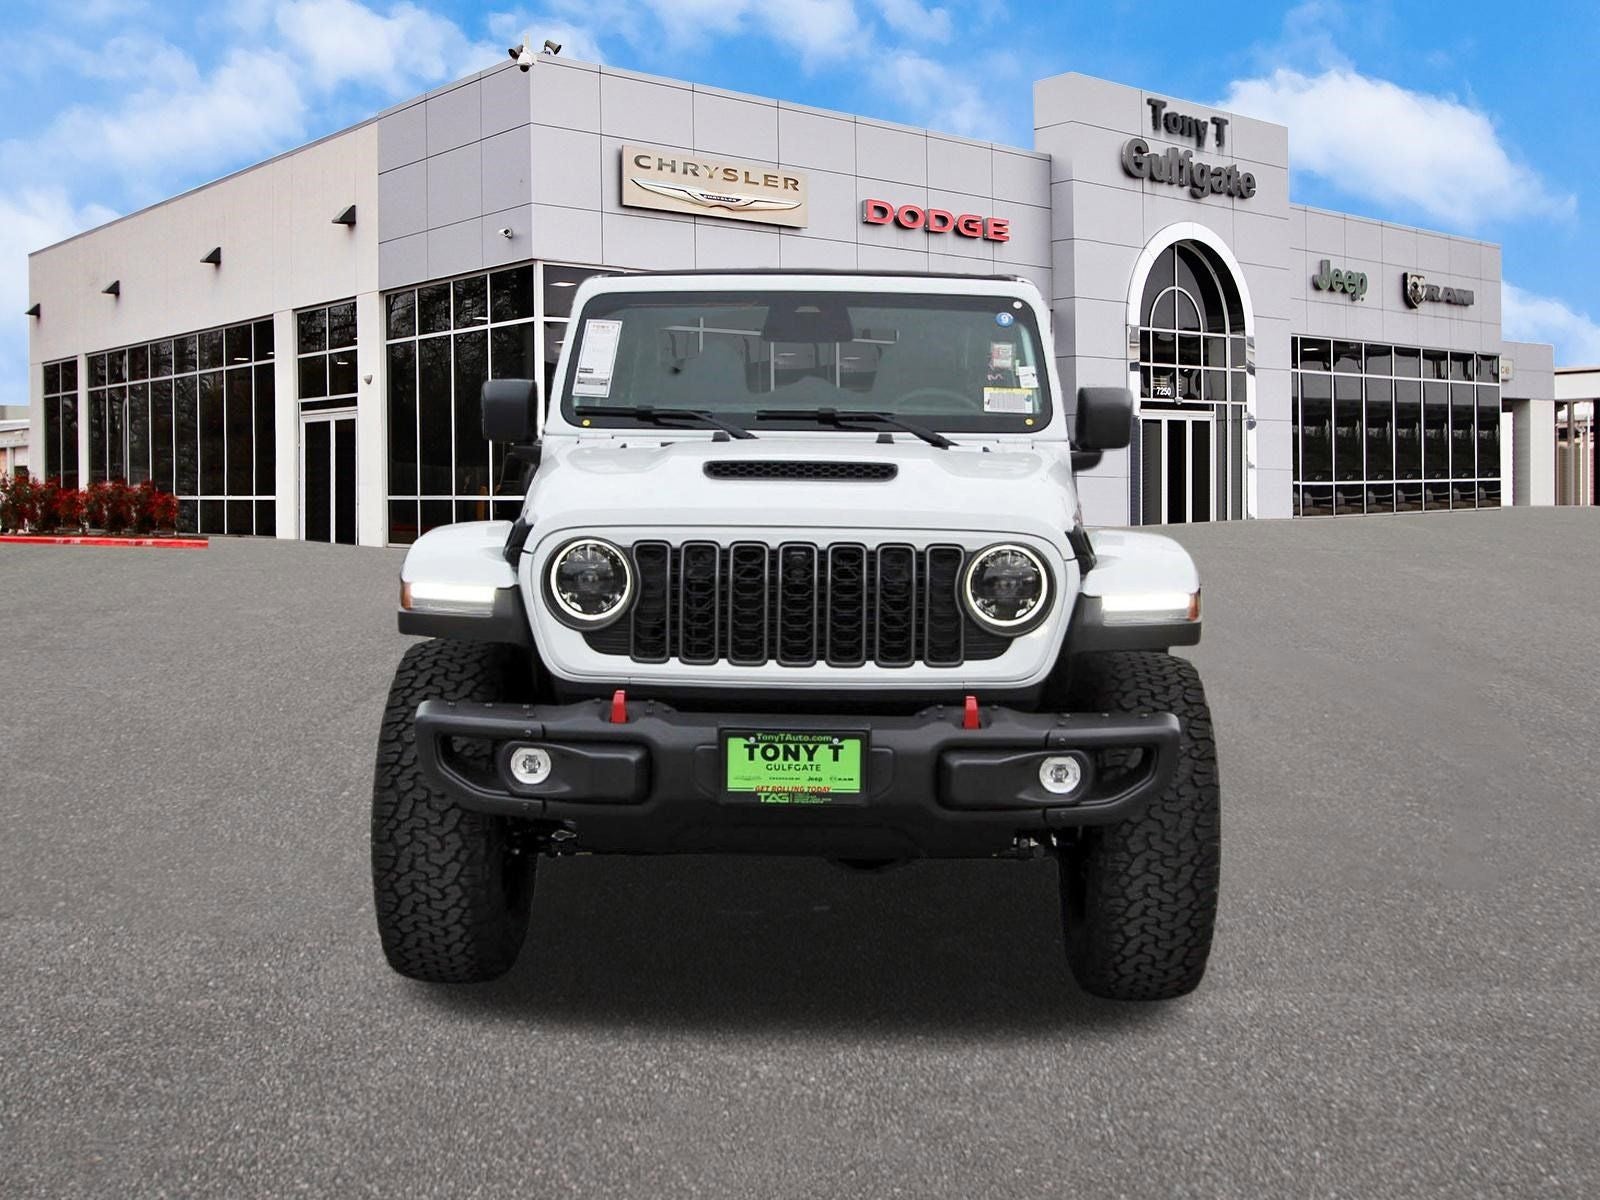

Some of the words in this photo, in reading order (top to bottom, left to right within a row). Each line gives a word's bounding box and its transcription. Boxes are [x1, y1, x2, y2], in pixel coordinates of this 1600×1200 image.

[1147, 98, 1208, 147] Tony
[1210, 117, 1229, 147] T
[634, 154, 800, 192] CHRYSLER
[1121, 138, 1256, 199] Gulfgate
[863, 199, 1009, 242] DODGE
[1312, 259, 1368, 301] Jeep
[1425, 284, 1475, 306] RAM
[1156, 386, 1171, 396] 7250
[744, 744, 818, 762] TONY
[828, 745, 844, 762] T
[756, 733, 832, 742] TonyTAuto.com
